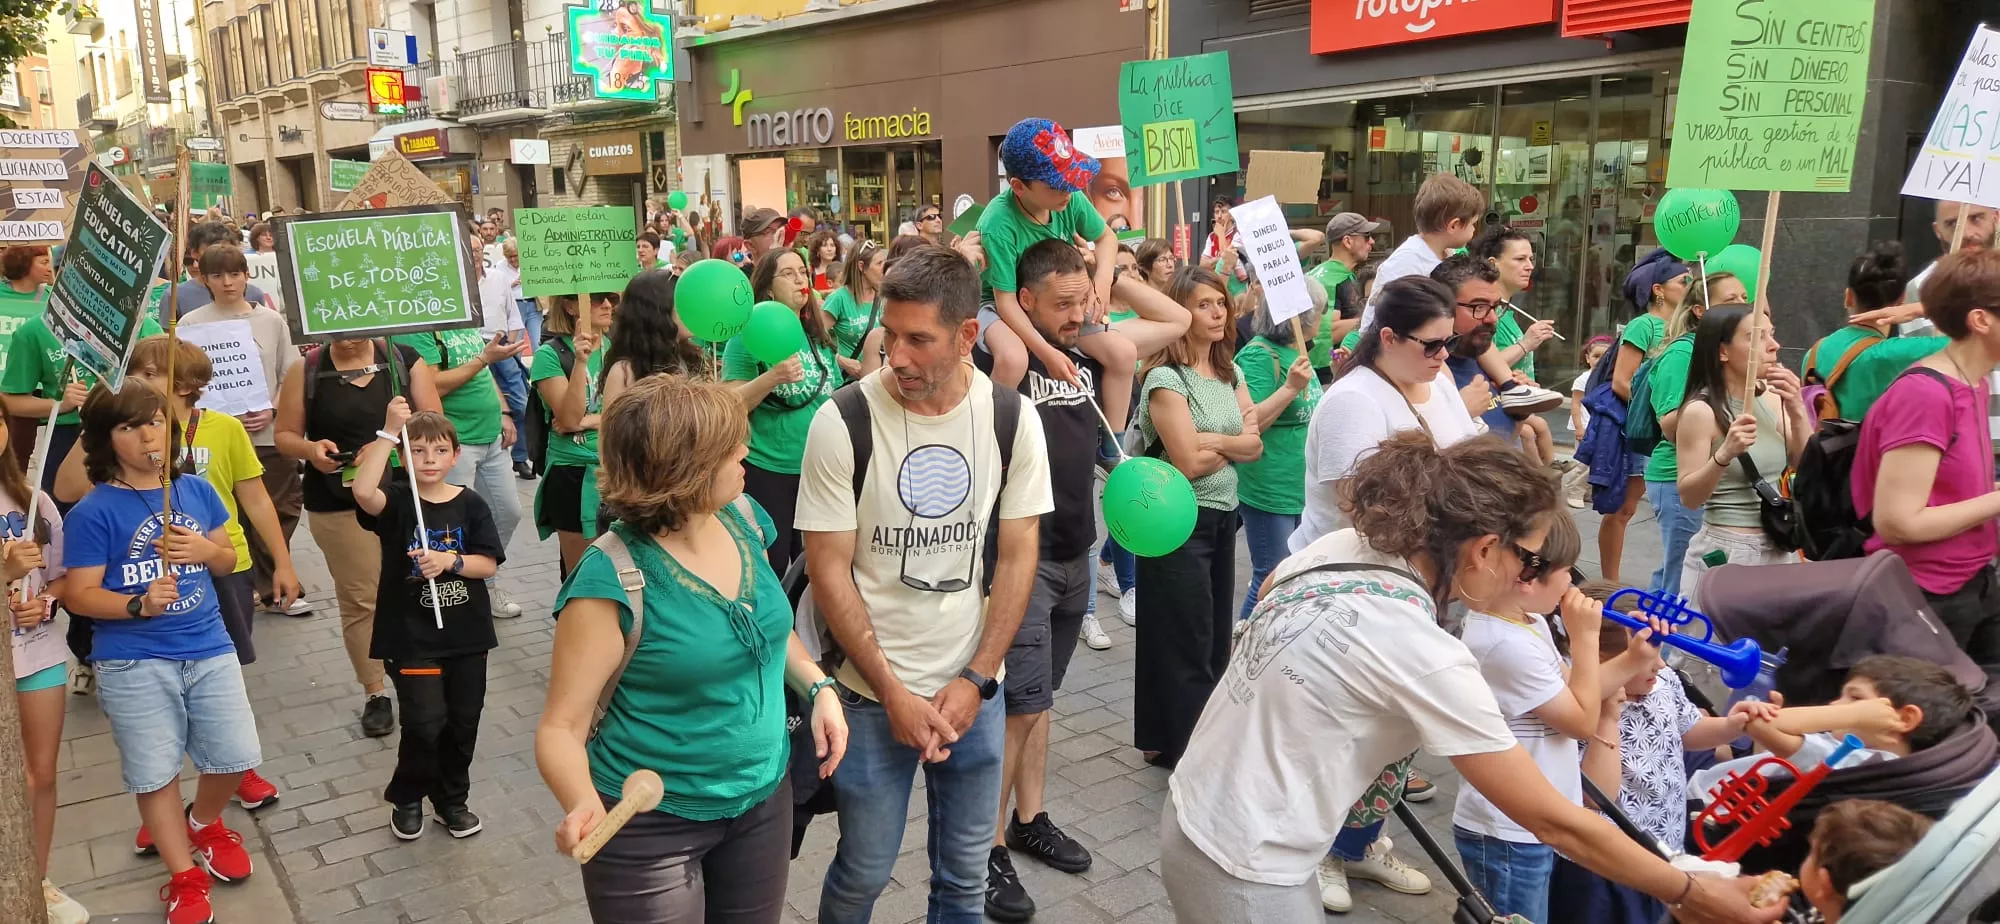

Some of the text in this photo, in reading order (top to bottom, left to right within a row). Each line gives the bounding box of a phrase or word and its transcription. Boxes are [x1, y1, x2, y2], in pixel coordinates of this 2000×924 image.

[1131, 60, 1219, 102] La pública
[1, 131, 70, 145] DOCENTES
[747, 107, 931, 147] marro farmacia
[1687, 118, 1752, 141] vuestra
[1763, 120, 1819, 153] gestión
[1827, 123, 1840, 143] de
[589, 145, 633, 158] CUARZOS
[1146, 128, 1195, 172] BASTA
[0, 162, 64, 176] LUCHANDO
[1699, 143, 1849, 184] pública es un MAL
[1924, 155, 1985, 198] ¡YA!
[97, 194, 139, 243] HUELGA
[1252, 223, 1278, 238] DINERO
[83, 207, 143, 274] EDUCATIVA
[306, 226, 451, 253] ESCUELA PÚBLICA:
[521, 227, 635, 242] los ADMINISTRATIVOS
[522, 247, 538, 259] de
[543, 245, 561, 257] los
[1263, 254, 1290, 272] PARA LA
[79, 256, 115, 296] CONTRA LA
[590, 261, 601, 269] No
[607, 261, 621, 269] me
[328, 266, 439, 290] DE TOD@S
[320, 297, 457, 324] PARA TOD@S
[200, 341, 241, 352] DINERO
[212, 366, 250, 378] ARA LA
[130, 521, 157, 559] WHERE
[870, 545, 902, 557] BORN
[422, 580, 468, 596] STAR
